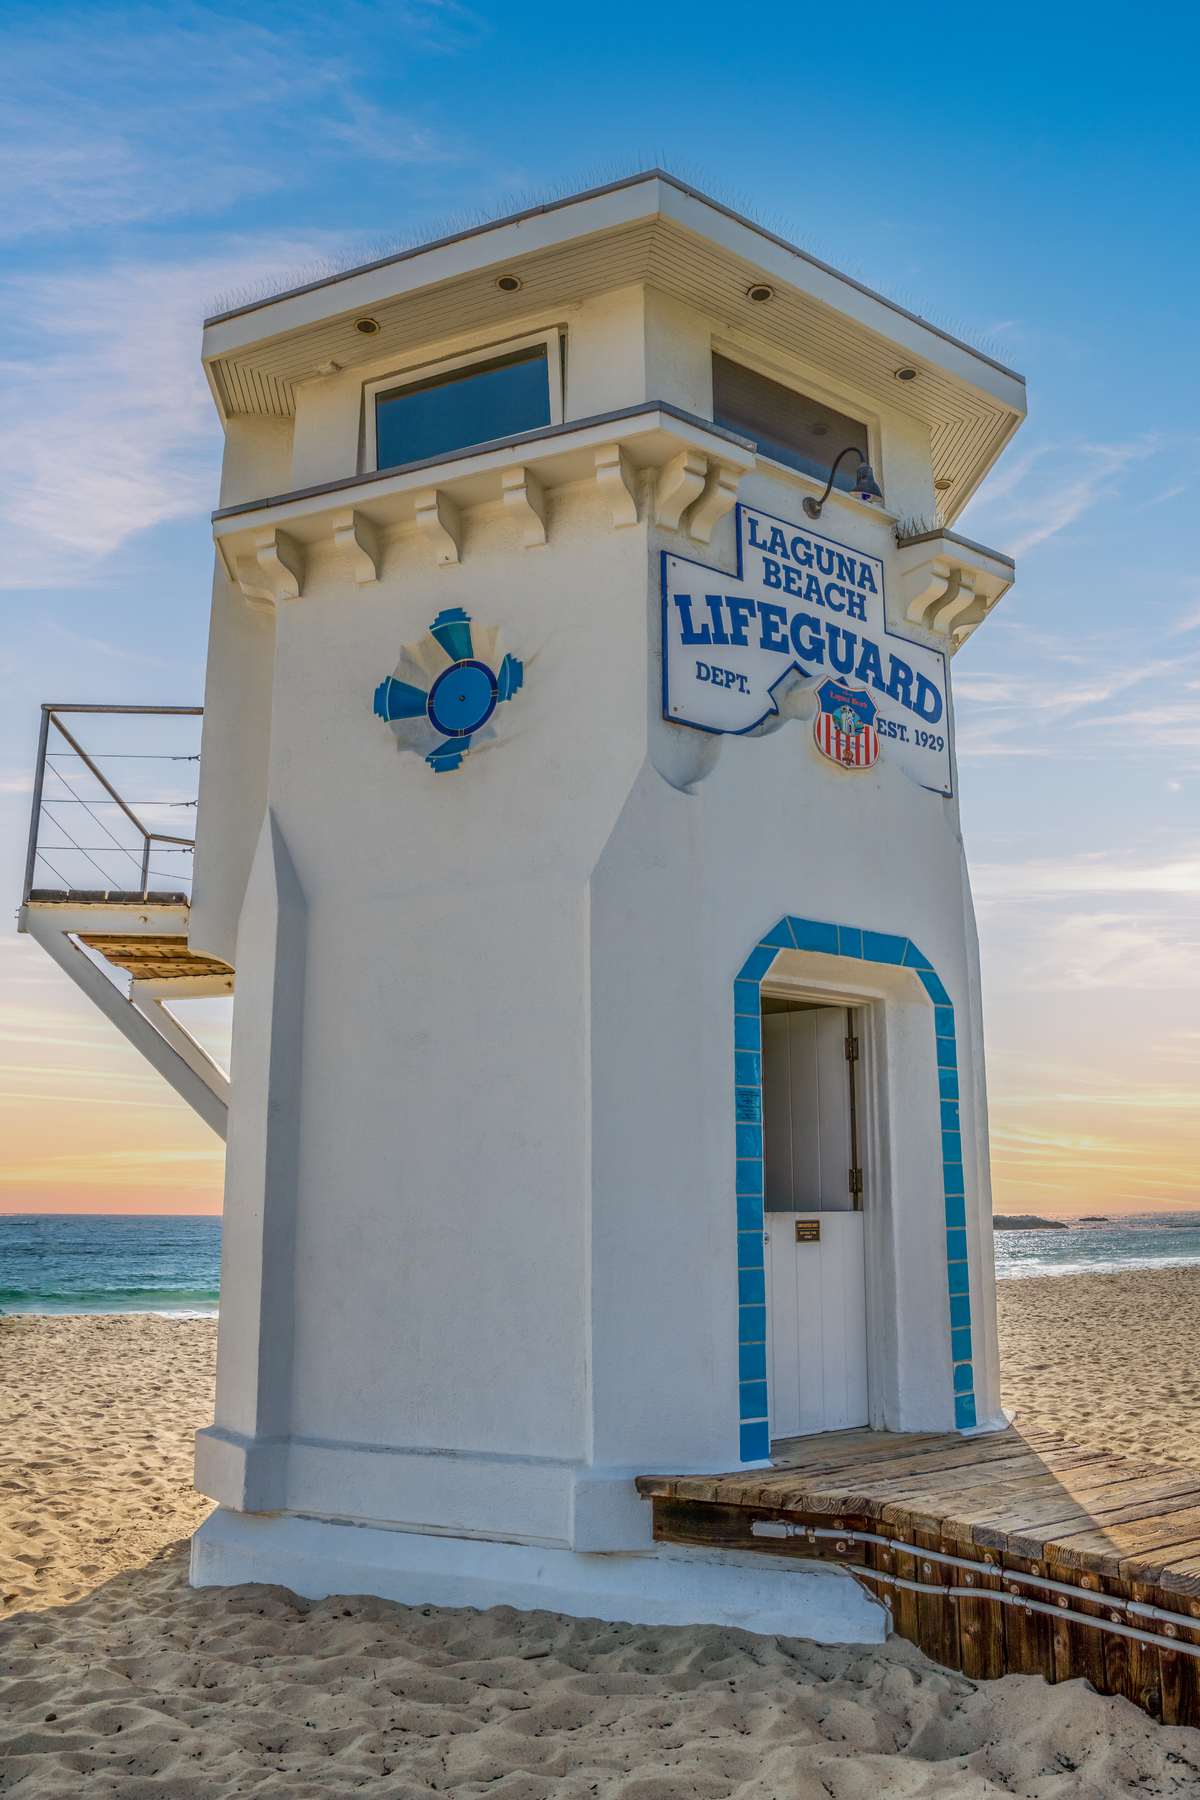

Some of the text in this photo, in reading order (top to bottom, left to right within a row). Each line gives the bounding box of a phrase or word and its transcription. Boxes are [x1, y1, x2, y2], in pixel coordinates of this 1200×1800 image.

[748, 517, 878, 594] LAGUNA
[762, 556, 868, 623] BEACH
[673, 594, 943, 724] LIFEGUARD
[695, 661, 751, 695] DEPT.
[876, 717, 910, 743] EST.
[914, 732, 945, 752] 1929
